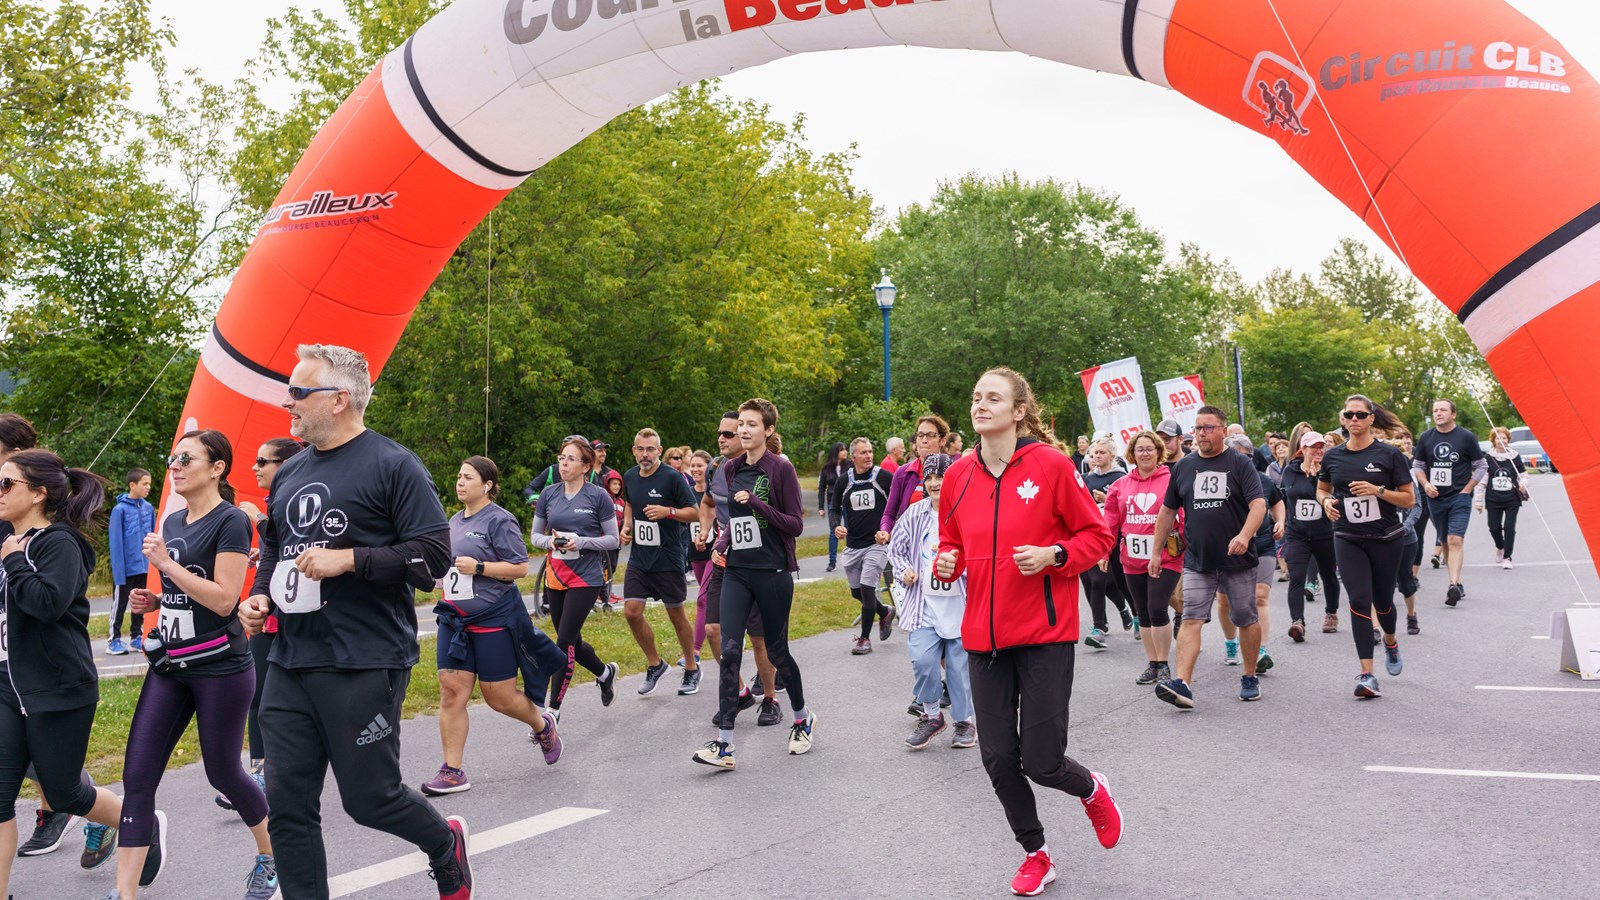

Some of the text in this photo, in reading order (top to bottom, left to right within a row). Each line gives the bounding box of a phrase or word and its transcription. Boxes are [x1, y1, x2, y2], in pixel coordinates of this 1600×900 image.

[679, 9, 722, 42] la
[1319, 41, 1567, 92] Circuit CLB
[1504, 76, 1571, 94] Beauce
[1201, 476, 1219, 494] 43
[1435, 471, 1446, 483] 49
[1497, 478, 1508, 489] 32
[855, 492, 870, 507] 78
[1193, 500, 1223, 510] DUQUET
[1127, 505, 1135, 514] LA
[1301, 502, 1316, 517] 57
[1351, 499, 1370, 519] 37
[638, 524, 653, 542] 60
[734, 521, 753, 544] 65
[1132, 538, 1148, 555] 51
[284, 567, 299, 604] 9
[450, 572, 459, 595] 2
[161, 614, 183, 643] 54
[356, 725, 393, 746] adidas
